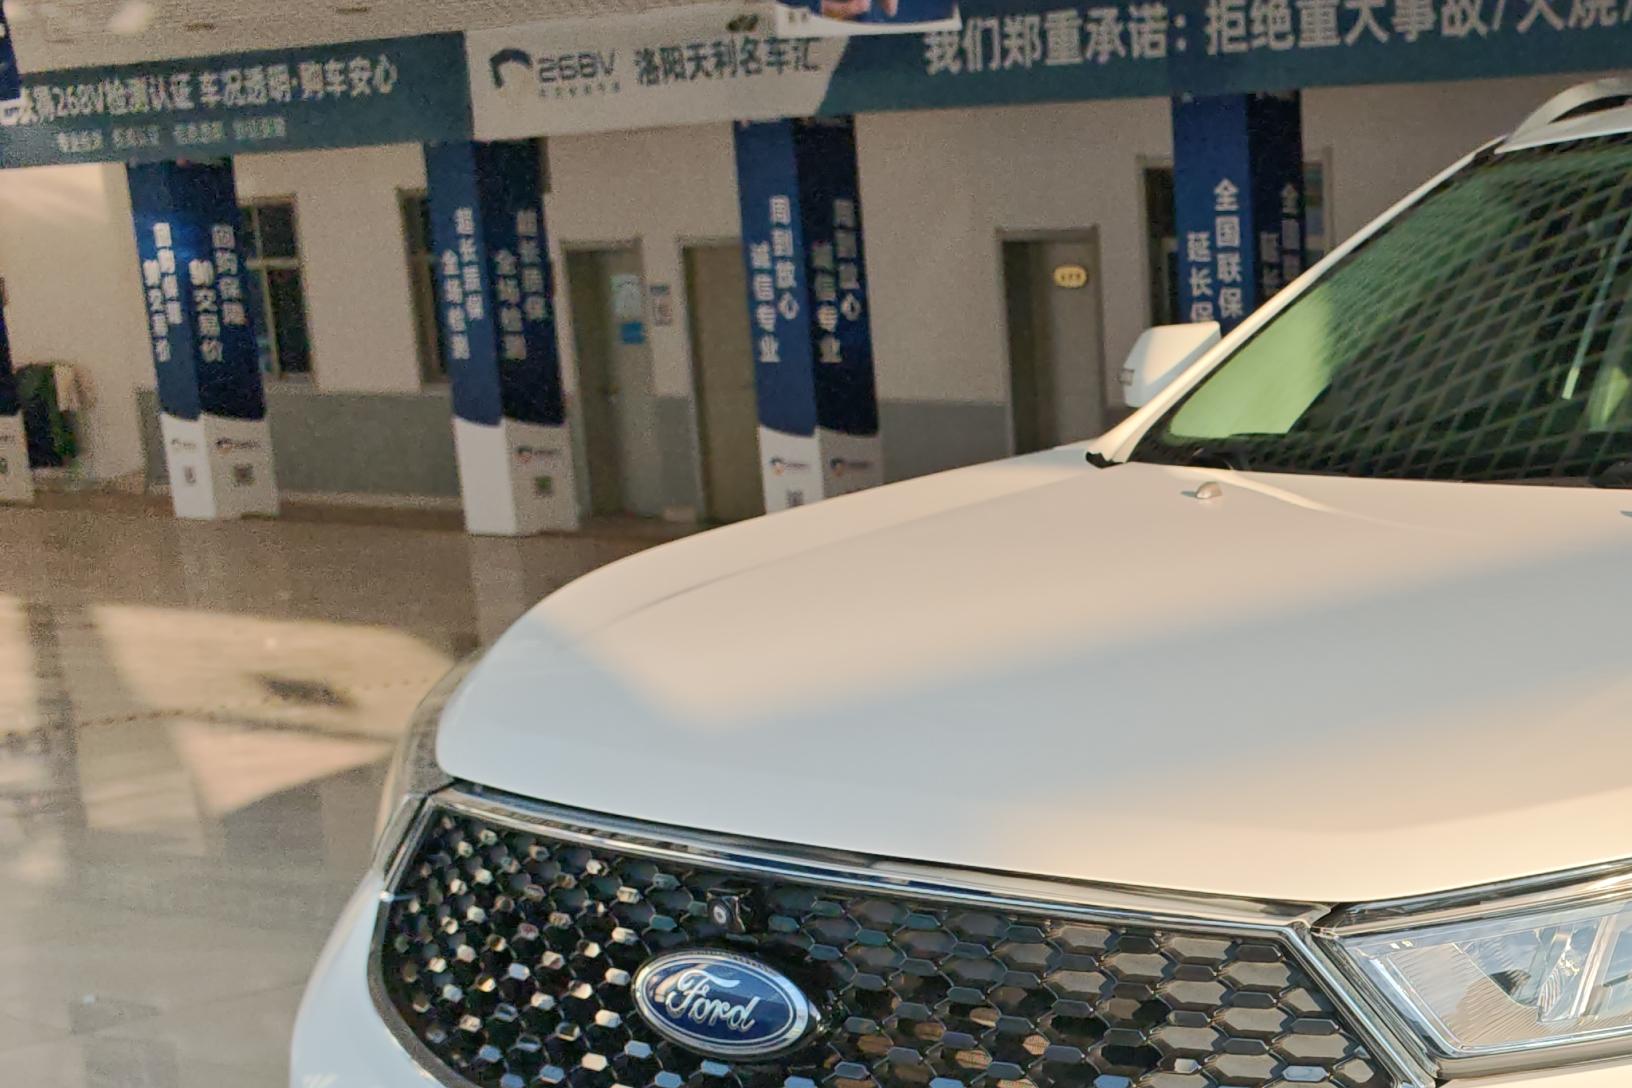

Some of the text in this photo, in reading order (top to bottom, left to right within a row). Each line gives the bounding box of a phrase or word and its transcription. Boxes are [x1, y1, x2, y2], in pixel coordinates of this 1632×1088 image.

[636, 36, 823, 86] 洛阳天利名车汇
[1213, 178, 1243, 319] 全国联保
[666, 969, 760, 1031] Ford
